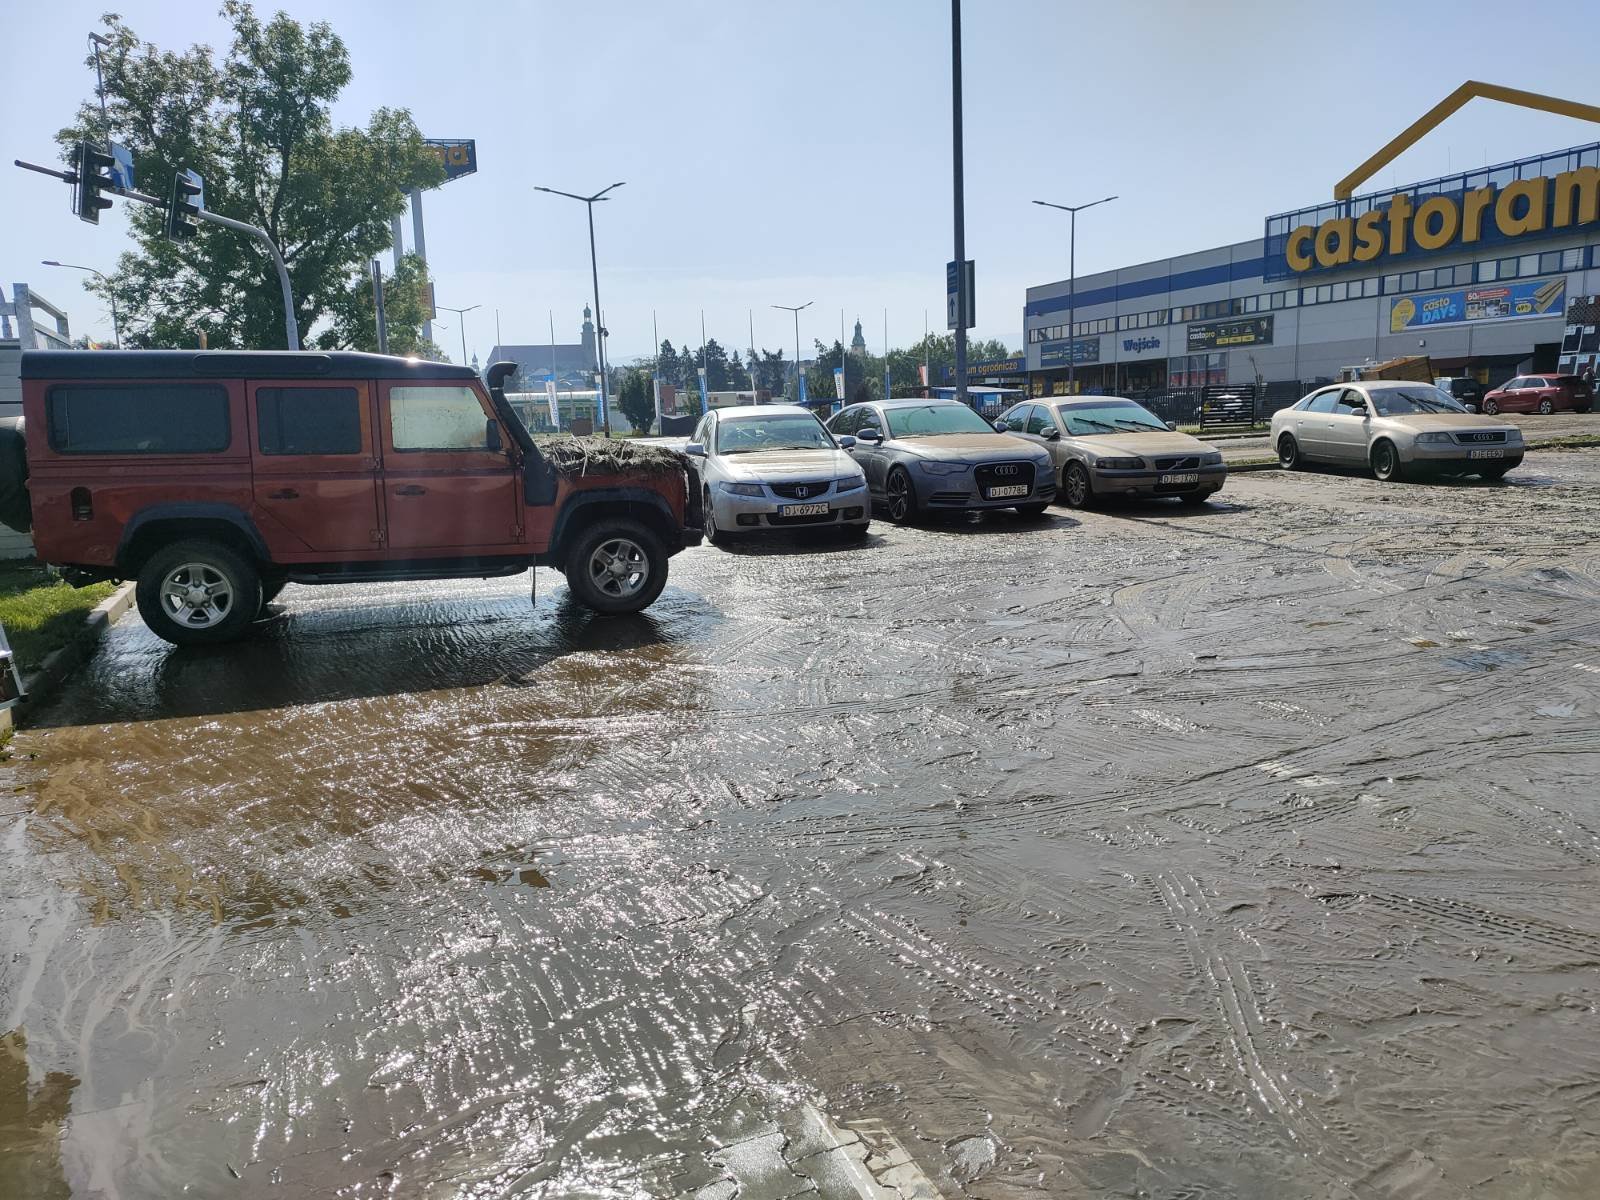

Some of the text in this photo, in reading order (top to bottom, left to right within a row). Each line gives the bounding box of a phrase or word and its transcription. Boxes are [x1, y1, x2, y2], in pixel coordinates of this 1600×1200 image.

[1423, 298, 1450, 312] casto
[1421, 304, 1457, 324] DAYS
[1189, 331, 1216, 341] castopro
[1123, 337, 1160, 354] Wejście
[978, 361, 1018, 375] ogrodnicze
